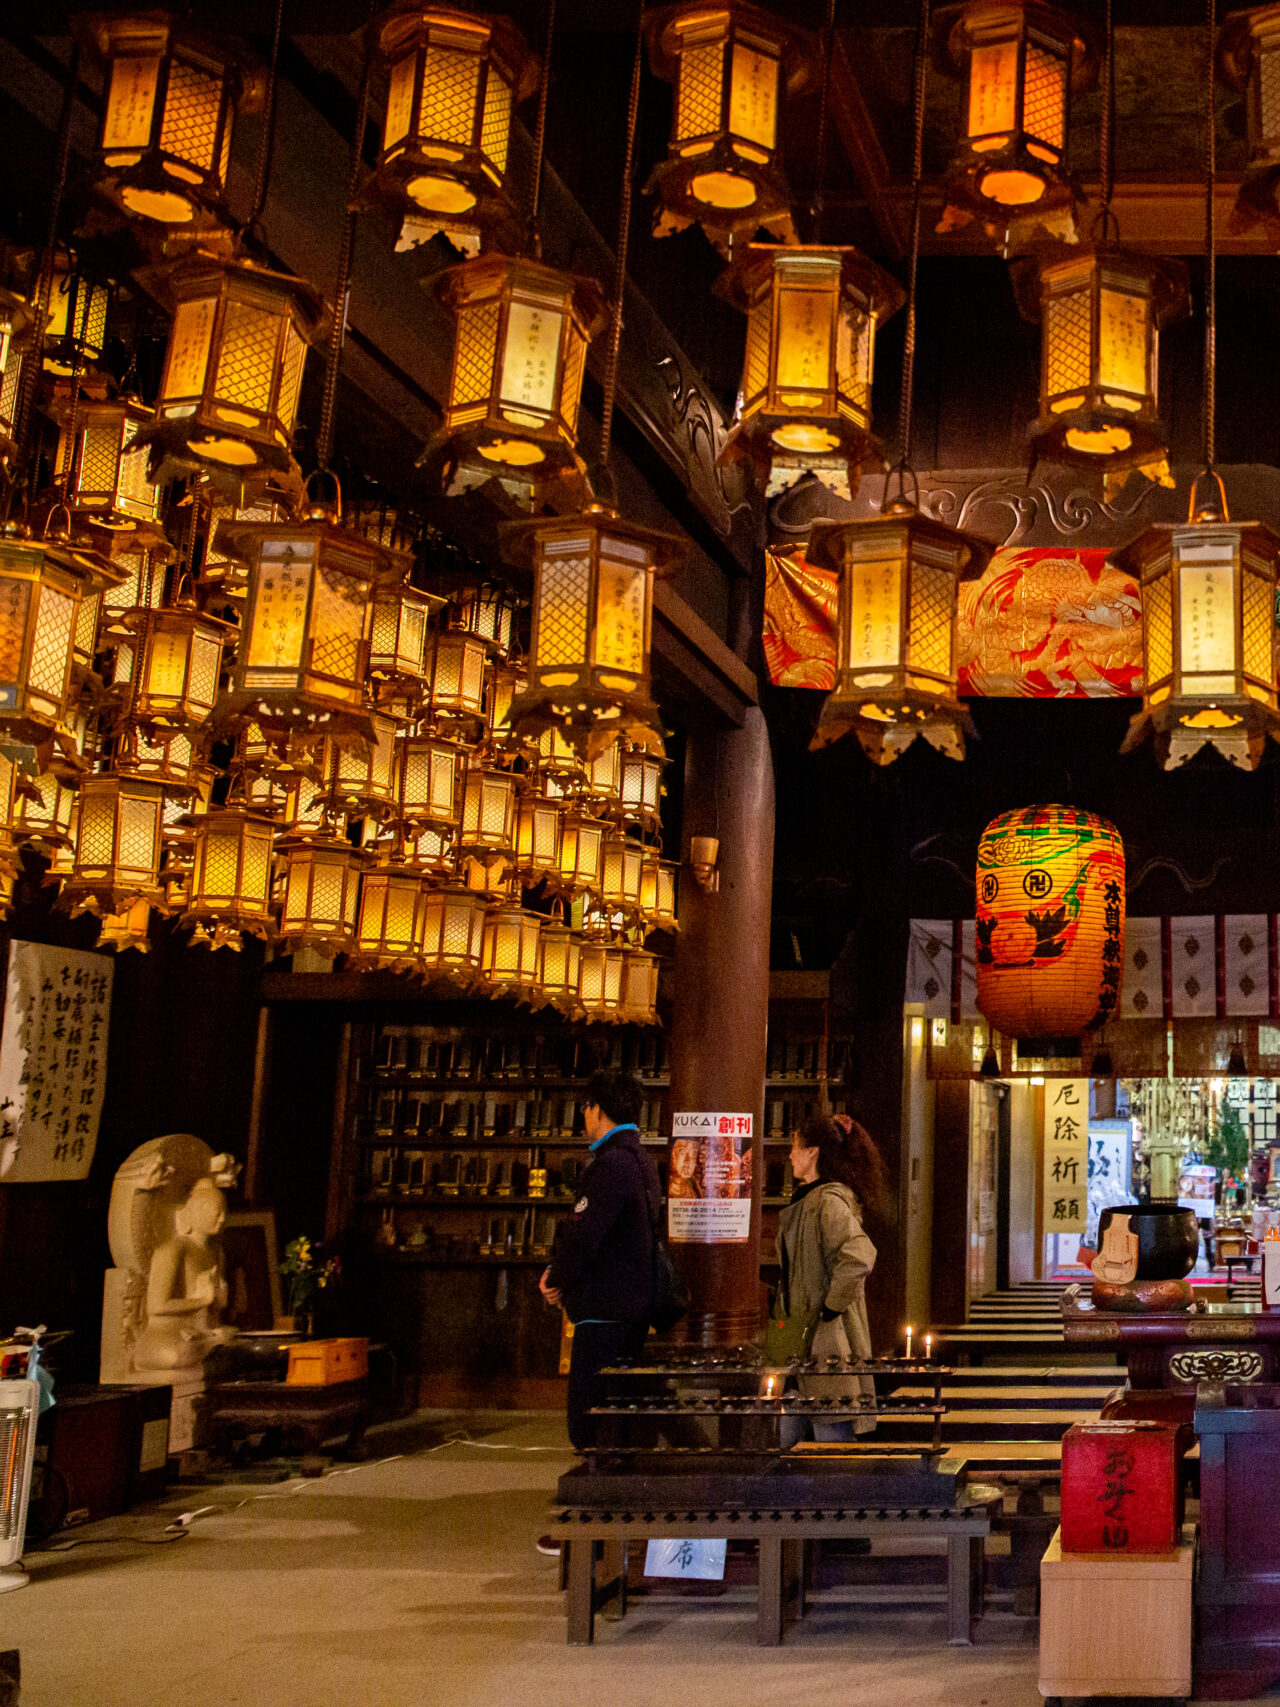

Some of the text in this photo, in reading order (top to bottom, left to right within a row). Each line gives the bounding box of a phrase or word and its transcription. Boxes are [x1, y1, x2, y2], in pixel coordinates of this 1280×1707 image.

[674, 1115, 751, 1134] KUKAI 創刊
[1051, 1084, 1080, 1220] 厄除祈願
[668, 1541, 694, 1569] 席
